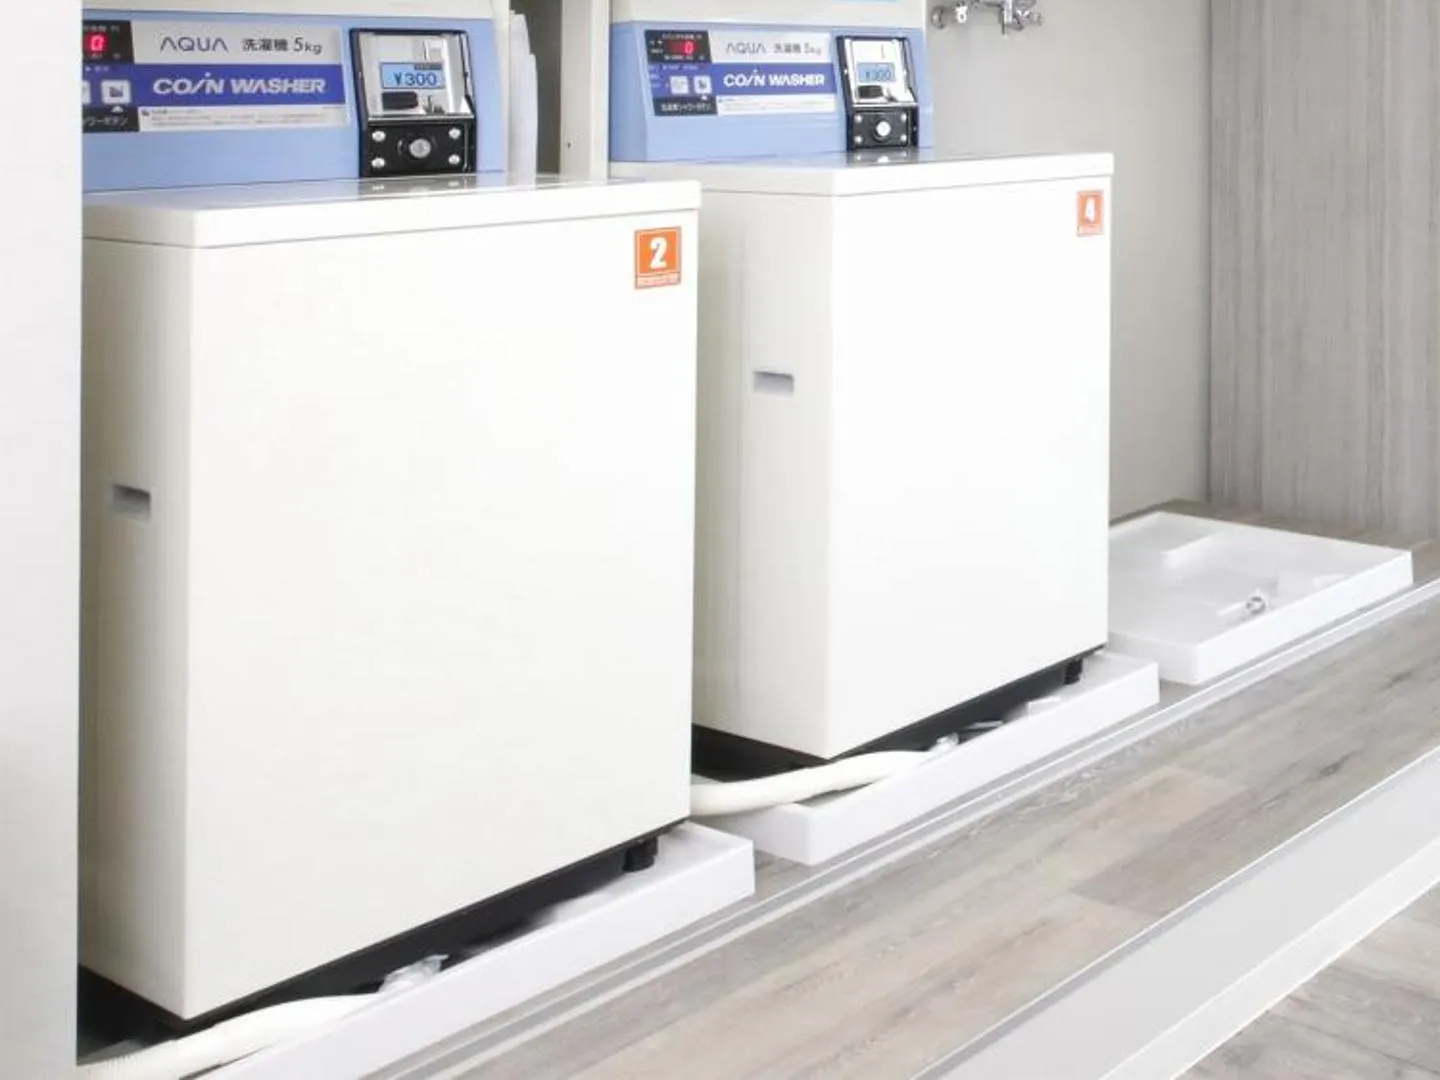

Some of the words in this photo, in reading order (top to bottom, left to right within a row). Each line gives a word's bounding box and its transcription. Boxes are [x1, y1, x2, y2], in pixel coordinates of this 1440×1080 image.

[91, 34, 104, 51] 0
[160, 36, 229, 52] AQUA
[242, 38, 289, 52] 洗濯機
[293, 37, 322, 55] 5kg
[684, 41, 694, 54] 0
[726, 42, 767, 54] AQUA
[230, 78, 326, 94] WASHER
[393, 72, 437, 86] ¥300
[769, 74, 825, 86] WASHER
[1084, 197, 1096, 222] 4
[650, 237, 667, 269] 2
